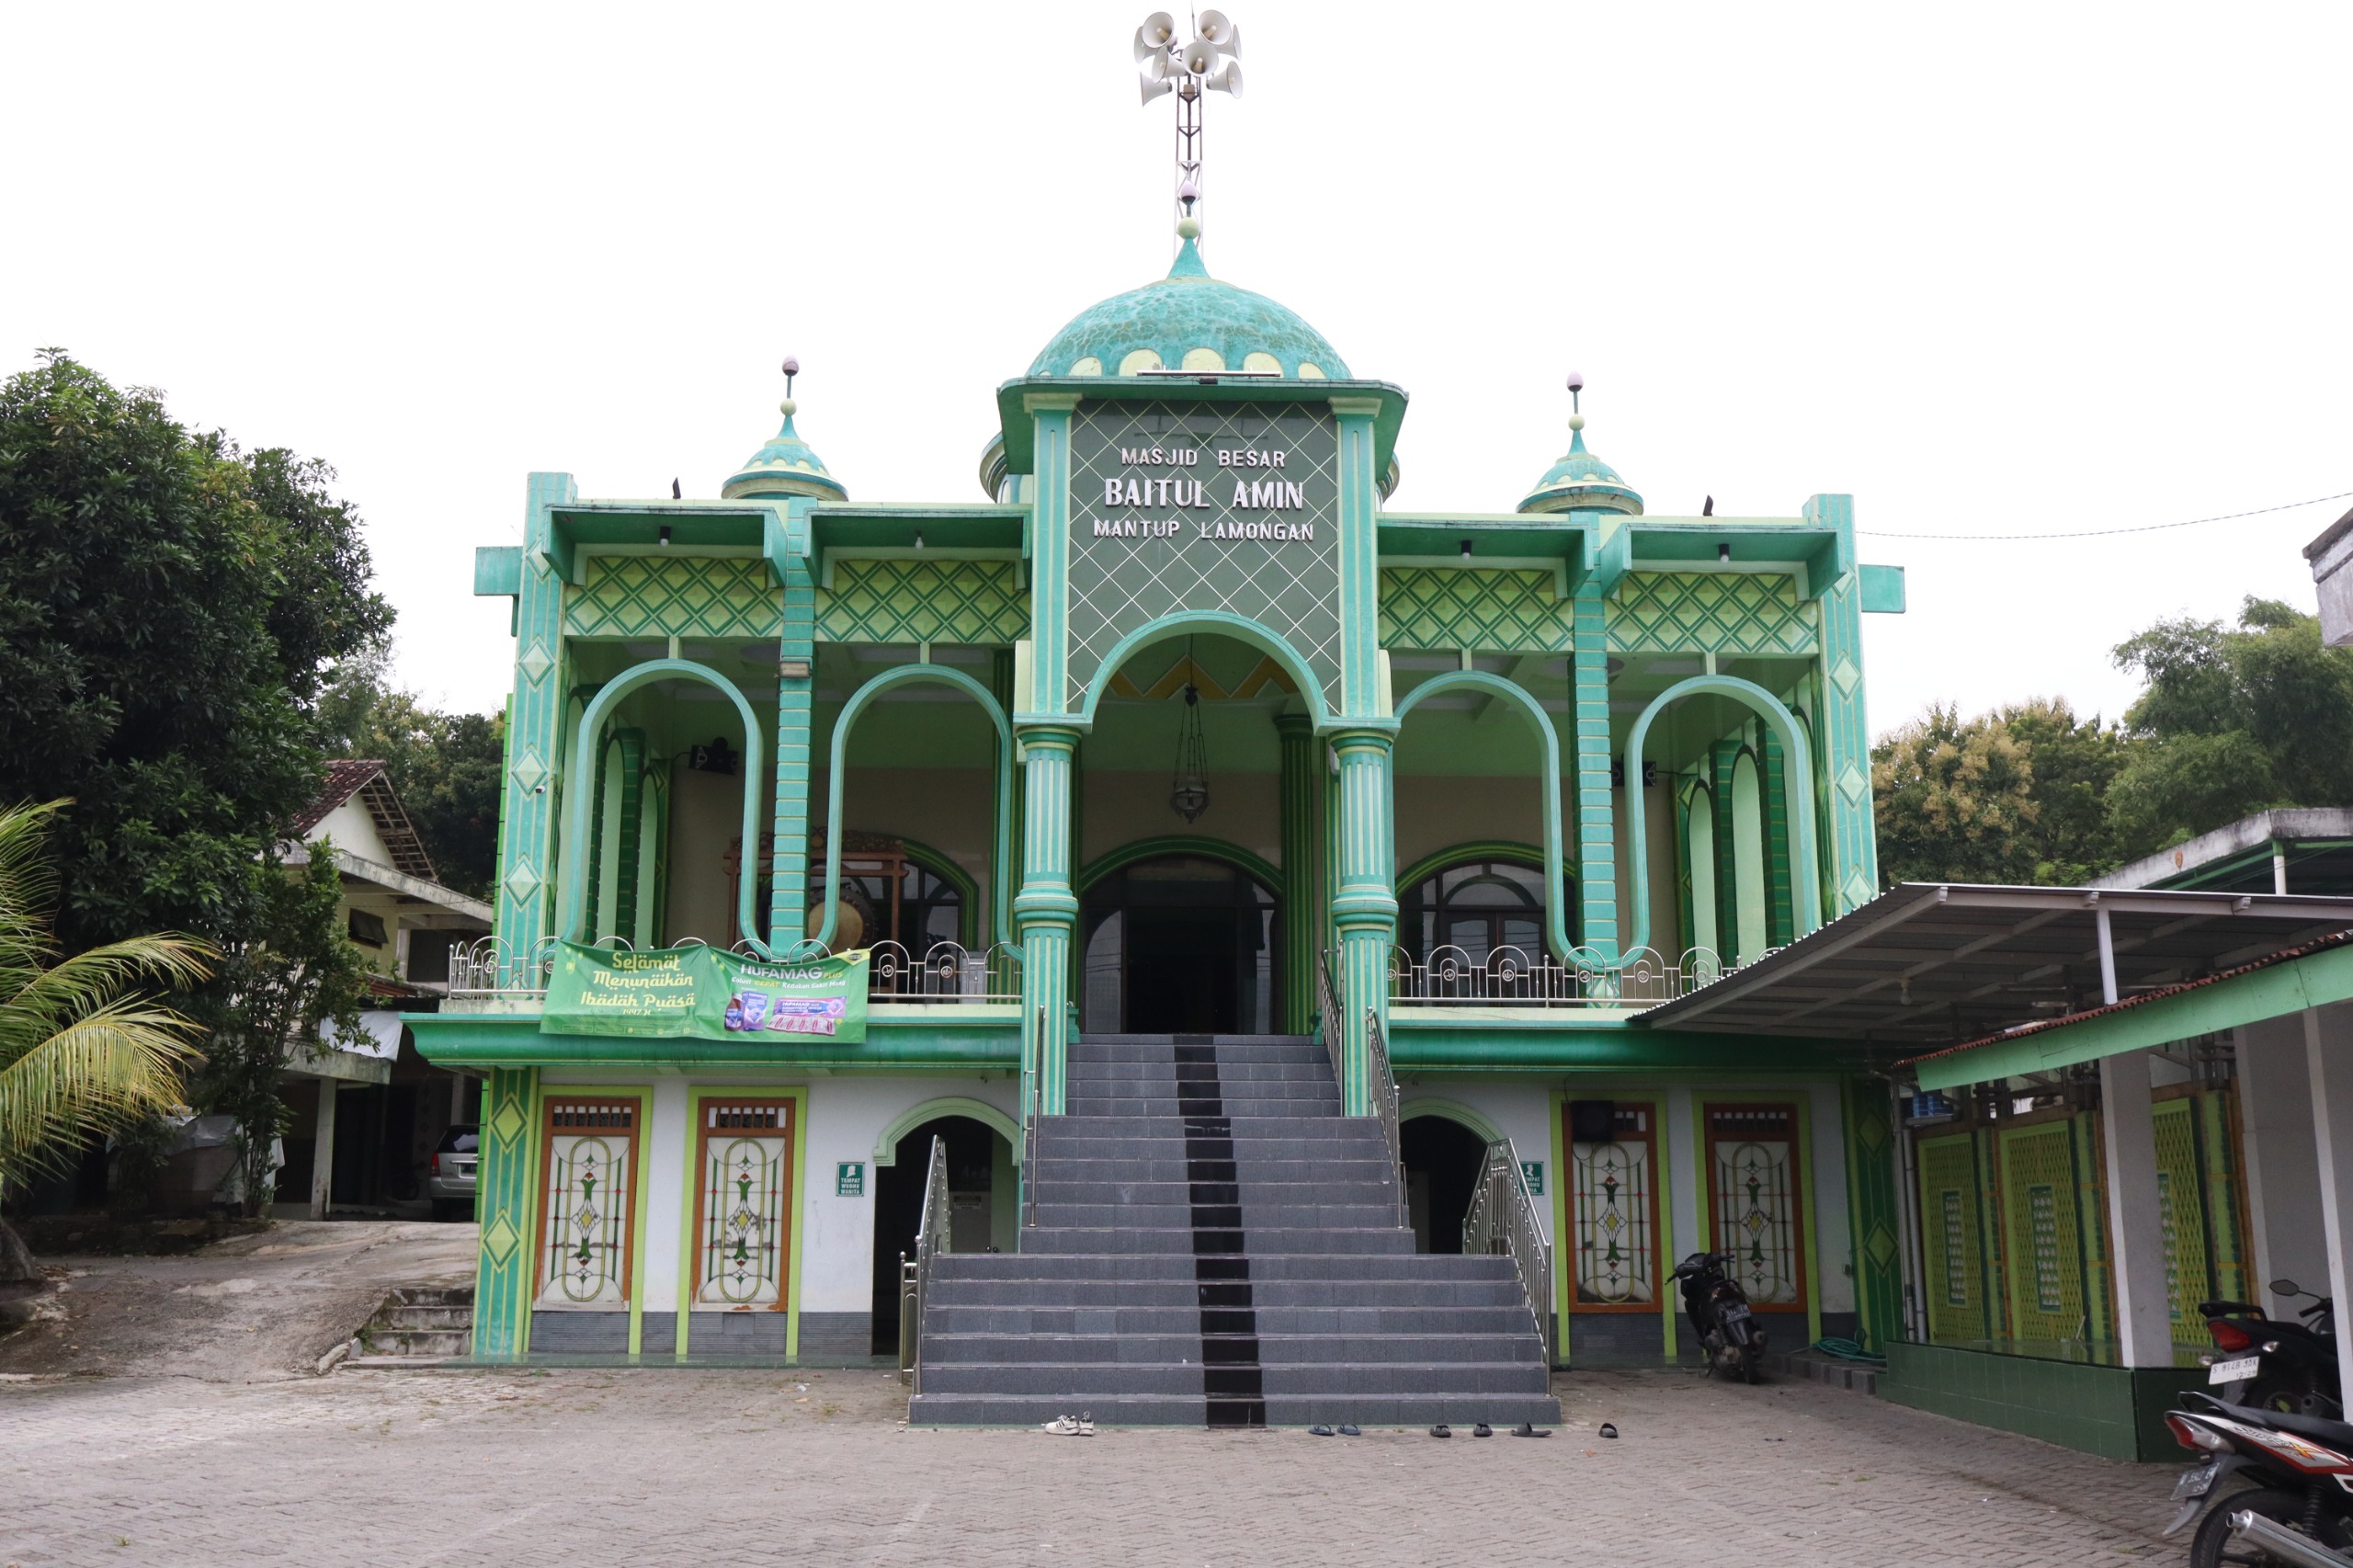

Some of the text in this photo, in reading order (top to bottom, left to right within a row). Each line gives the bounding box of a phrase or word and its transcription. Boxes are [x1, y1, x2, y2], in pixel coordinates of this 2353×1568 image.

[1121, 448, 1285, 468] MASJID BESAR
[1105, 478, 1303, 509] BAITUL AMIN
[1094, 519, 1313, 541] MANTUP LAMONGAN
[740, 963, 824, 980] HUFAMAG
[782, 981, 810, 989] Redakan
[580, 991, 696, 1011] Ibadah Puasa
[2212, 1365, 2218, 1374] S
